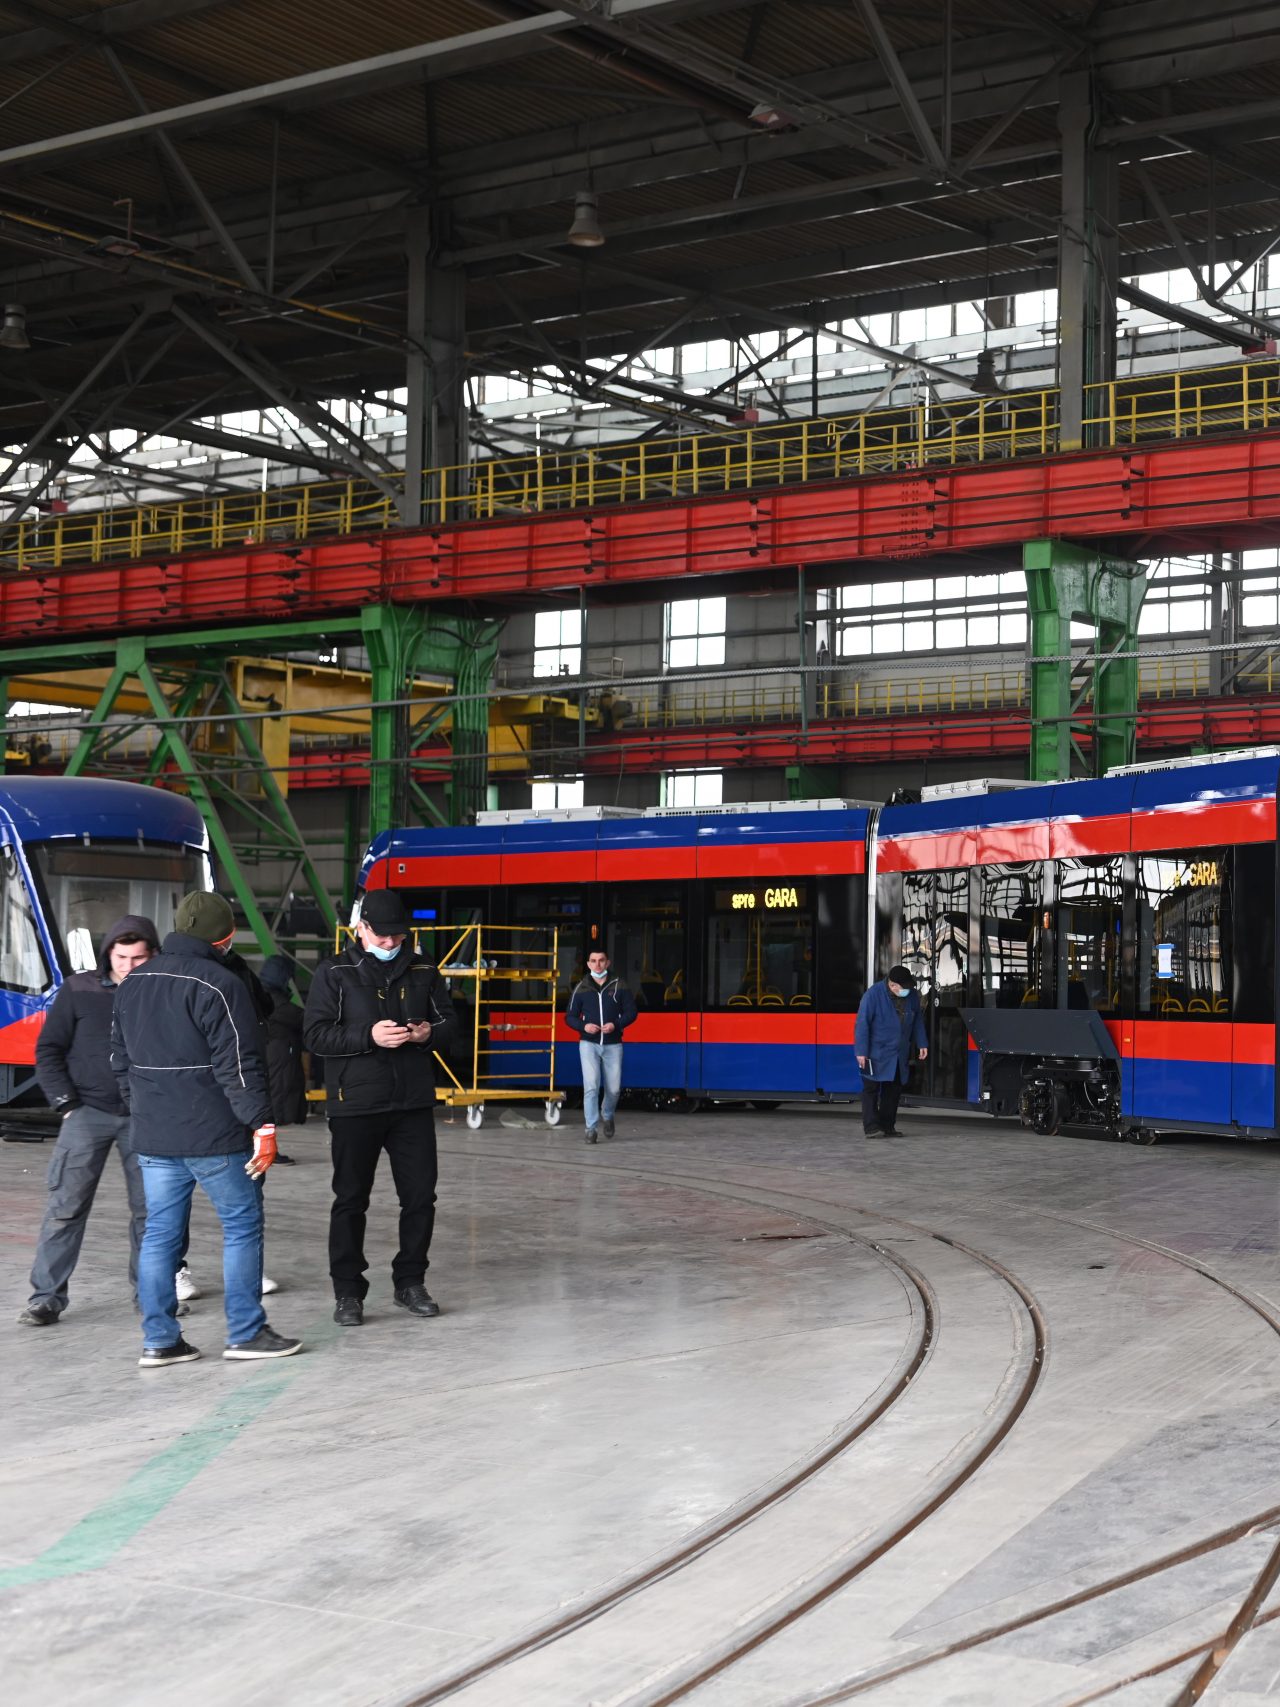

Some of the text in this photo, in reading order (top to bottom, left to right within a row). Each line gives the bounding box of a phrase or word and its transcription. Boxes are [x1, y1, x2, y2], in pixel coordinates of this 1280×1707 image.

[1190, 861, 1218, 887] GARA
[732, 887, 798, 909] spre GARA
